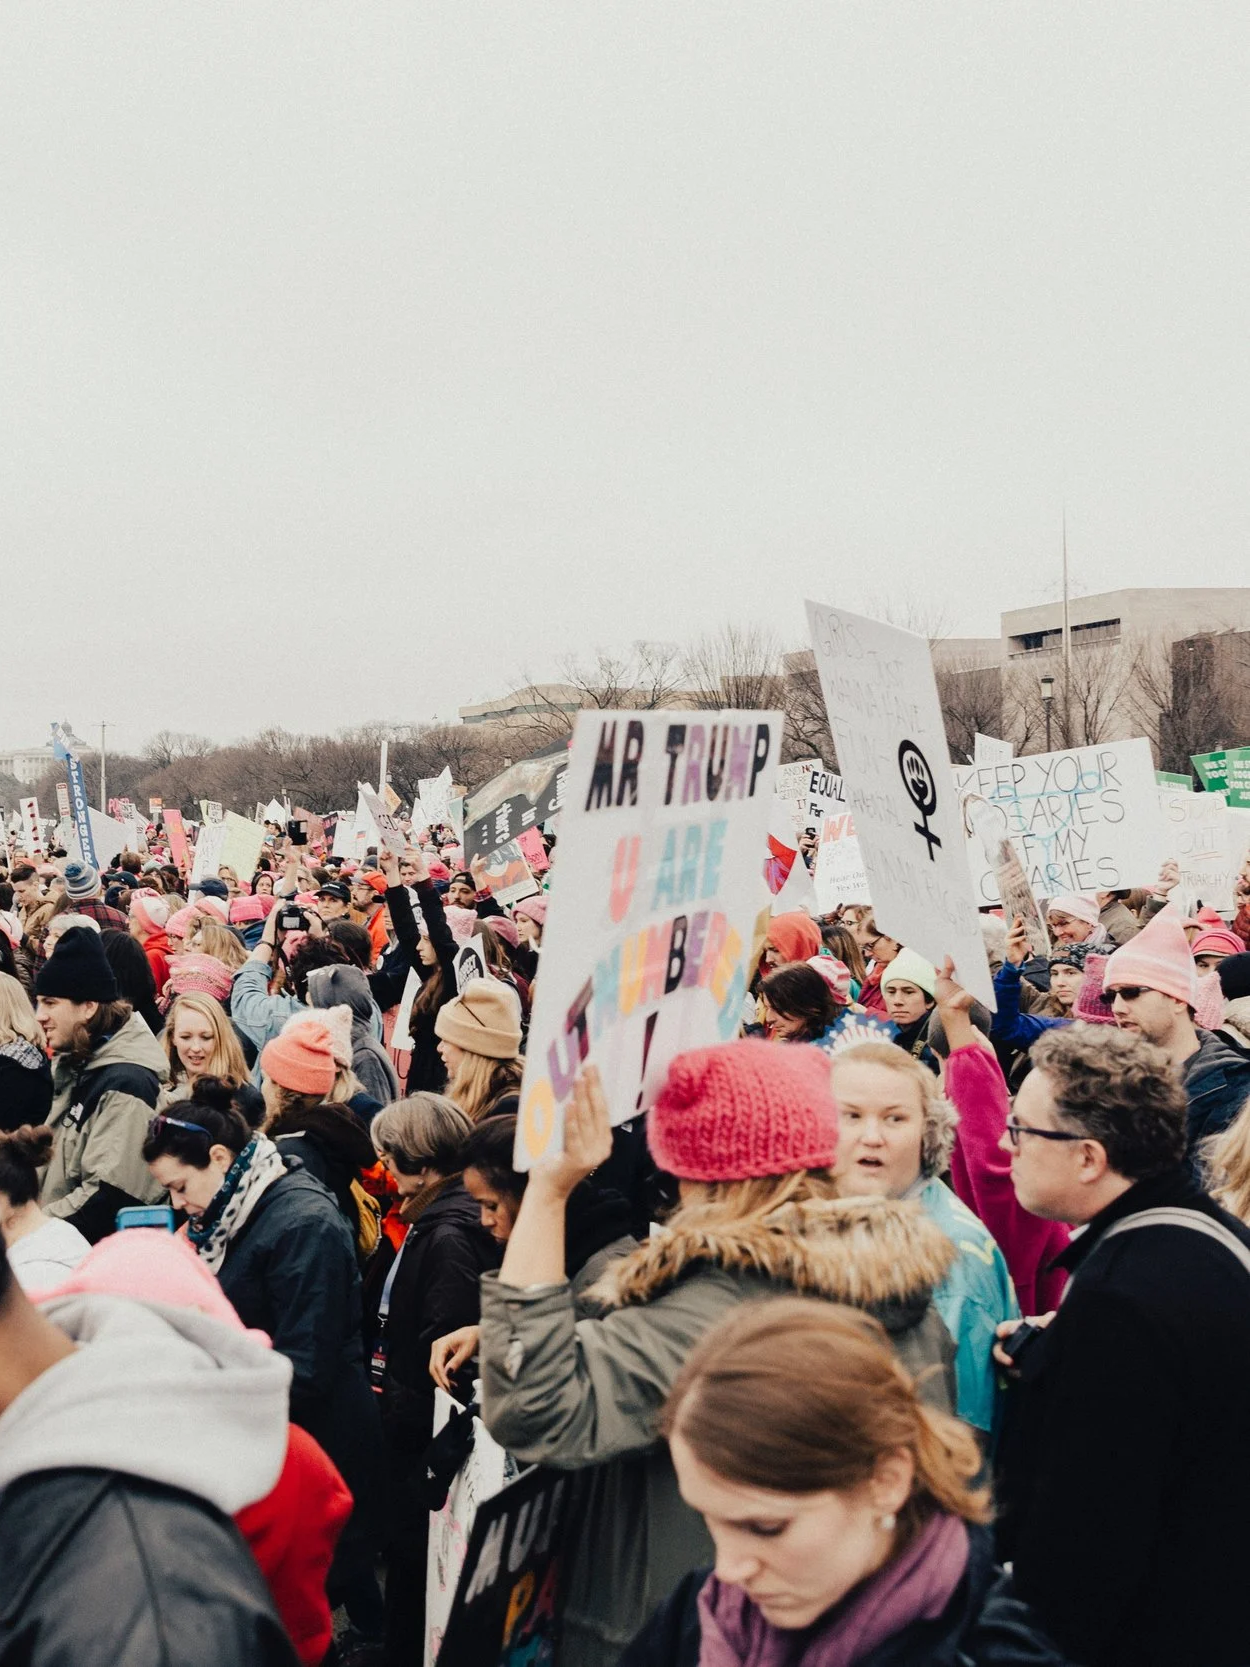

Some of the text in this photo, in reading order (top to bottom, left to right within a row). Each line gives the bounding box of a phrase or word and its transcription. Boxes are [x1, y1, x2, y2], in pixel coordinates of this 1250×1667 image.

[584, 719, 645, 812] MR
[664, 722, 770, 807] TRUMP
[810, 770, 846, 803] EQUAL
[956, 764, 1026, 800] KEEP
[1034, 751, 1123, 796] YOUR
[70, 759, 93, 864] STRONGER
[823, 814, 858, 844] WE
[993, 789, 1125, 832] OSARIES
[1054, 826, 1089, 862] MY
[609, 817, 729, 926] U ARE
[980, 857, 1121, 902] OARIES
[523, 910, 745, 1160] OUTNUMBERED
